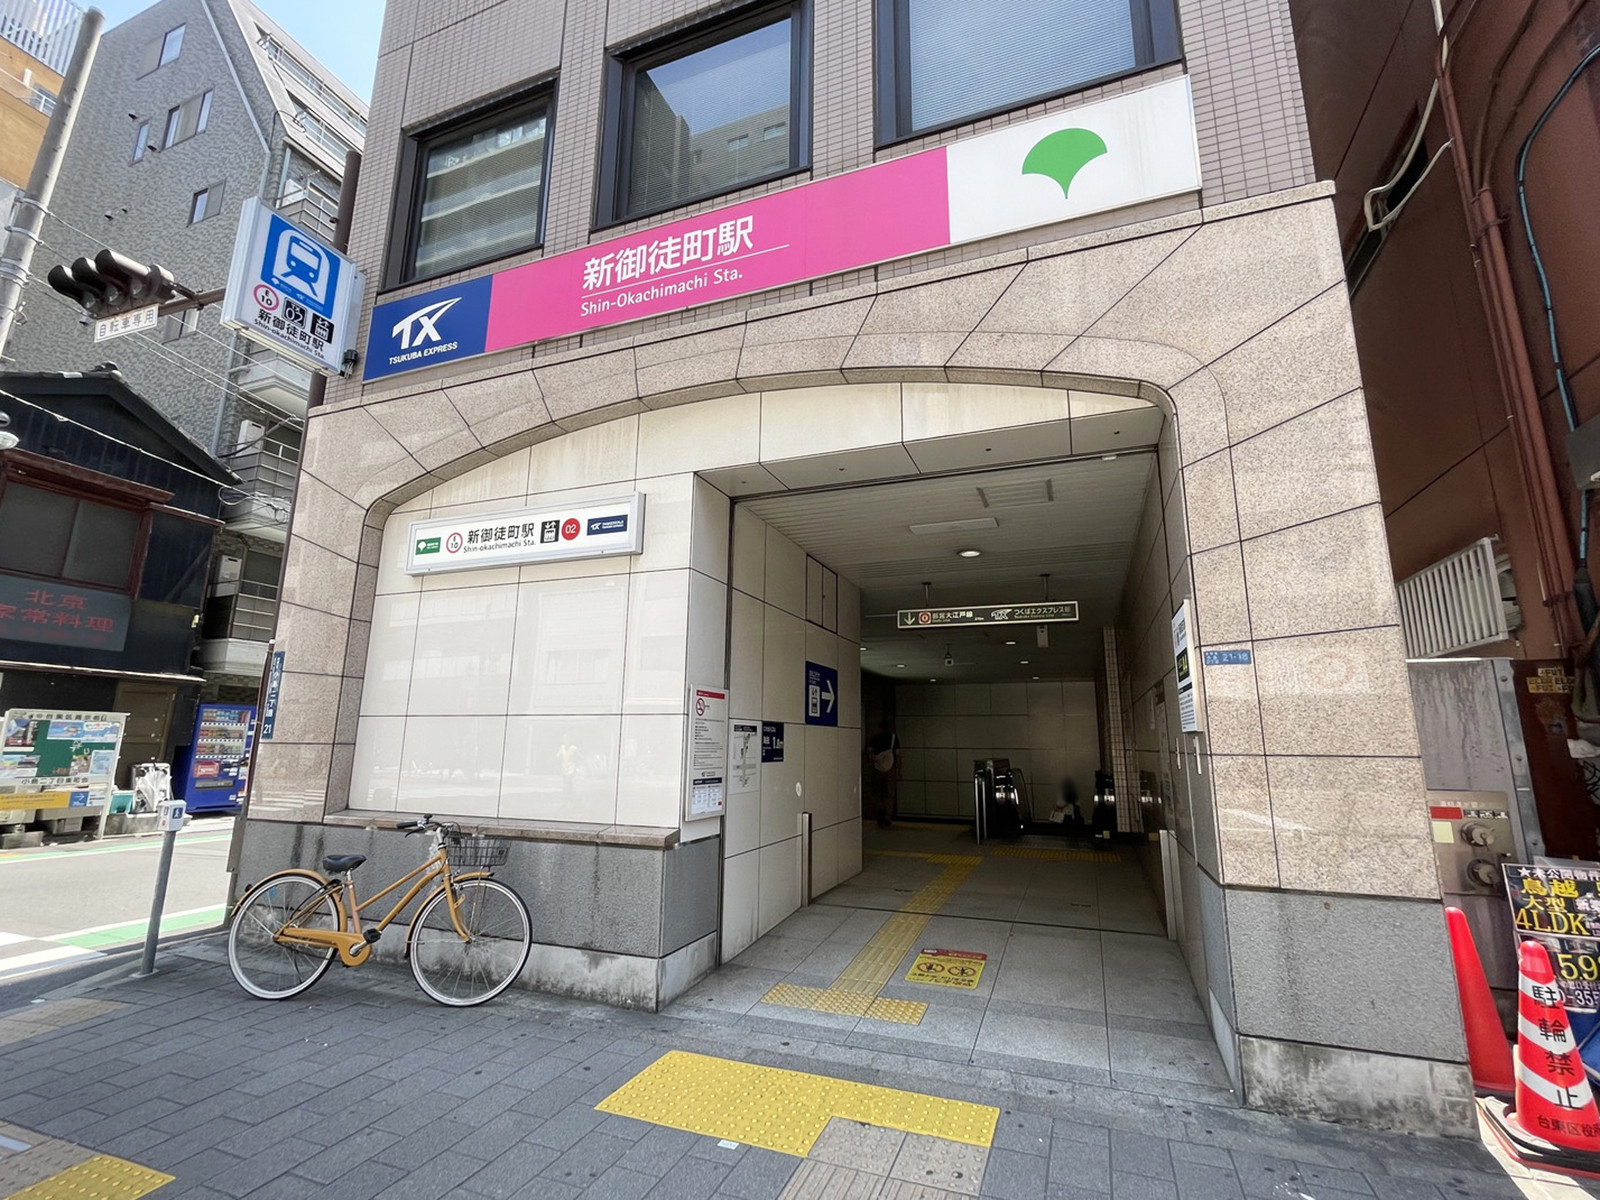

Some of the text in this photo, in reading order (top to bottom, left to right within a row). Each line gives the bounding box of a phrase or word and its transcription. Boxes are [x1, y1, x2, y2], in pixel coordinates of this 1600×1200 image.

[583, 215, 753, 291] 新御徒町駅
[580, 268, 743, 317] Shin-Okachimachi Sta.
[286, 308, 303, 325] 02
[391, 297, 463, 350] TX
[254, 318, 313, 354] Shin-okachimachi
[258, 308, 324, 352] 新御徒町駅
[388, 341, 459, 365] TSUKUBA EXPRESS
[467, 522, 535, 545] 新御徒町駅
[565, 523, 577, 535] 02
[463, 540, 522, 554] Shin-okachimachi
[25, 590, 88, 611] 北京
[263, 724, 272, 734] 21
[1521, 878, 1579, 898] 鳥越
[1523, 895, 1567, 913] 大型
[1516, 908, 1590, 935] 4LDK
[1532, 985, 1583, 1110] 駐輪禁止
